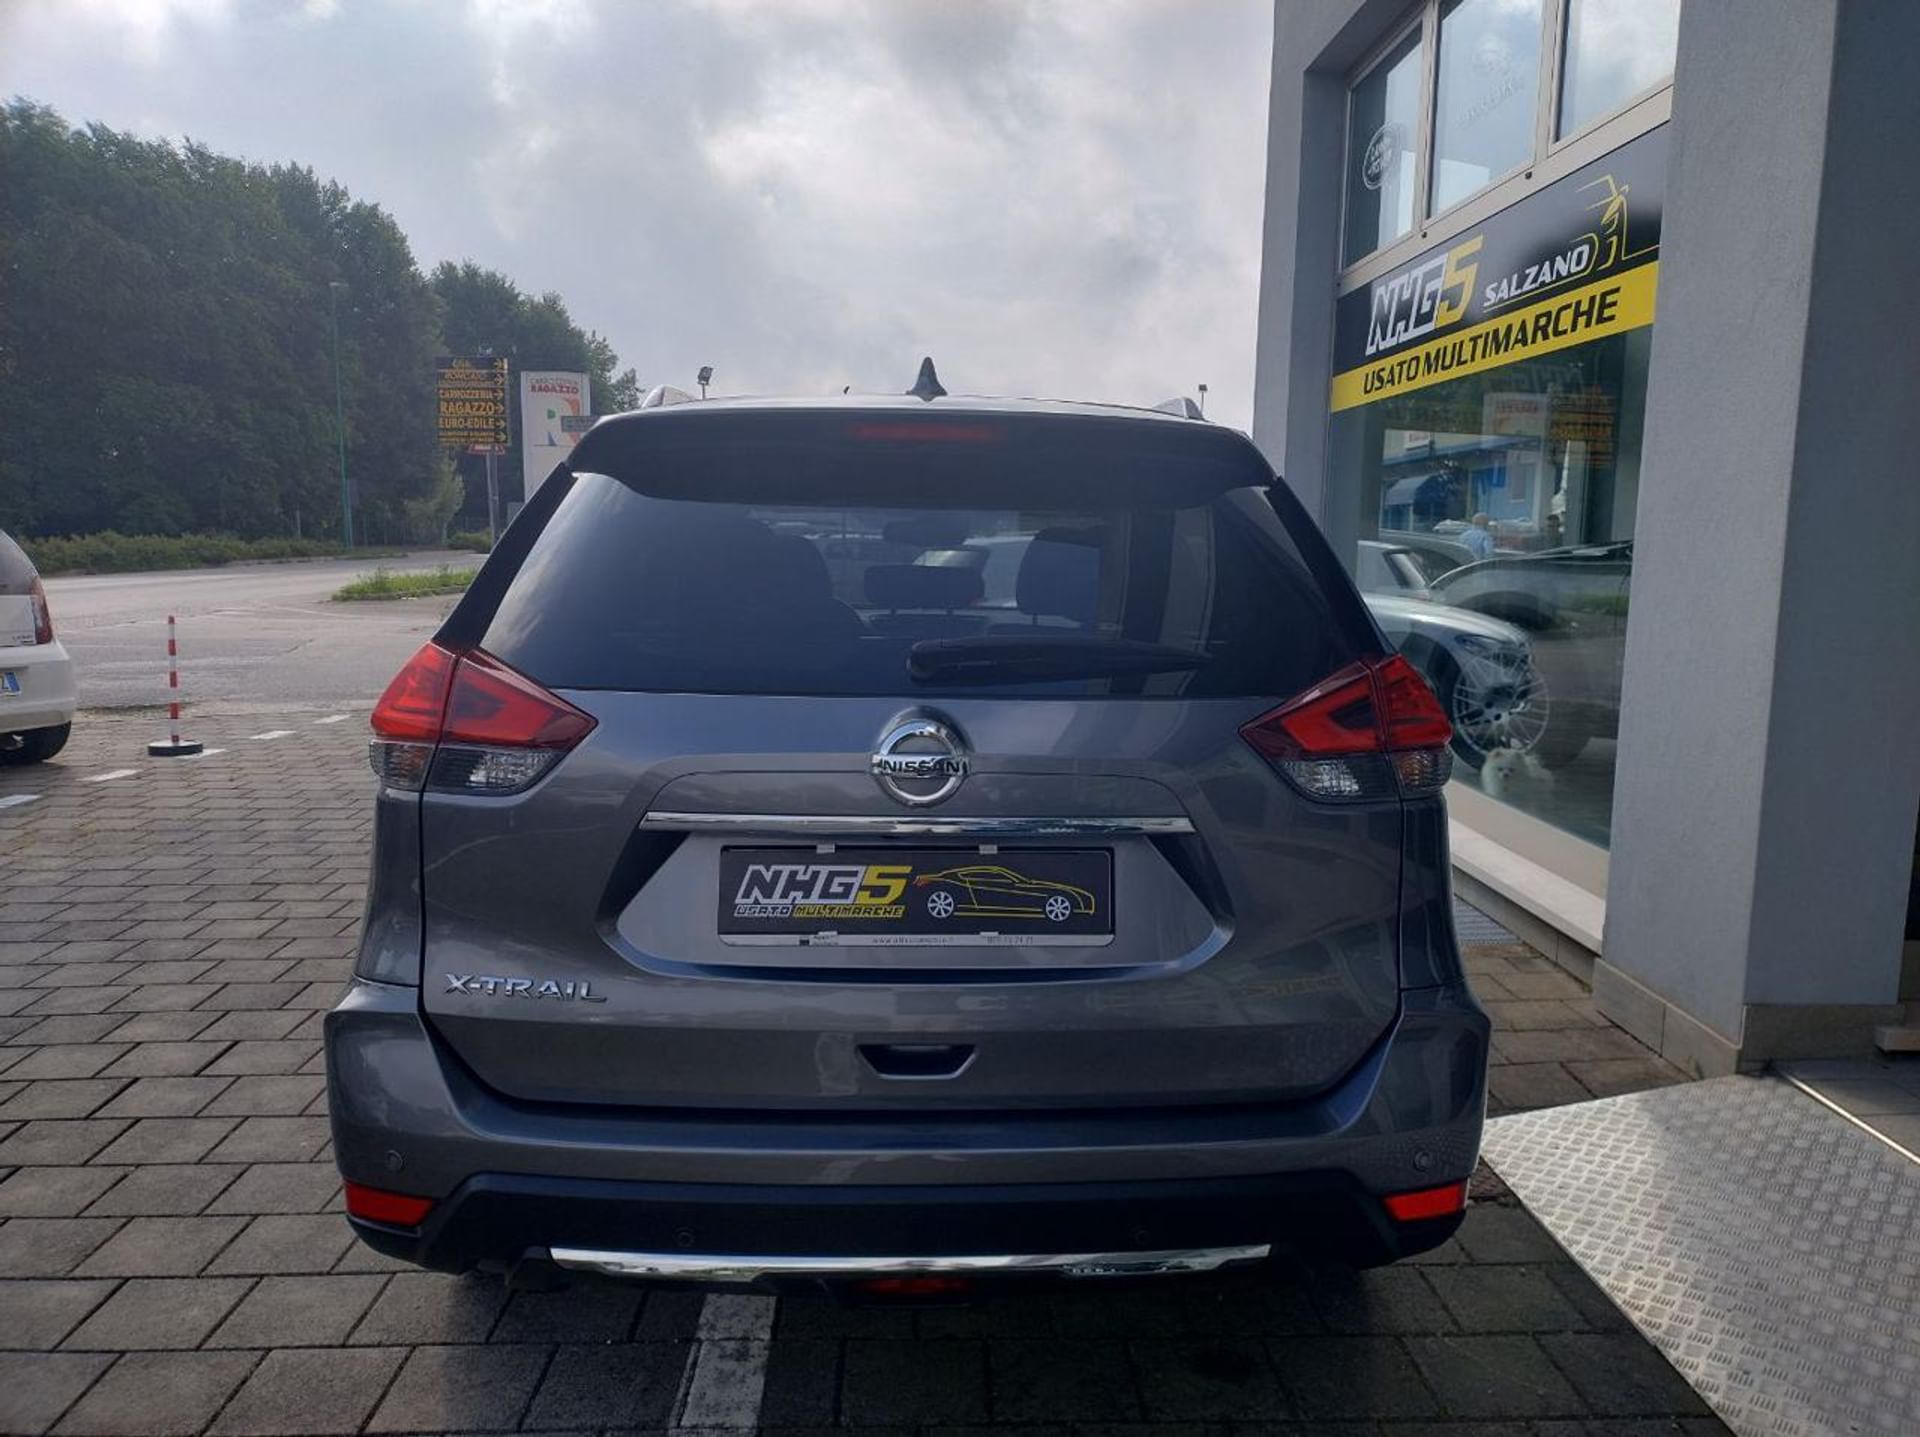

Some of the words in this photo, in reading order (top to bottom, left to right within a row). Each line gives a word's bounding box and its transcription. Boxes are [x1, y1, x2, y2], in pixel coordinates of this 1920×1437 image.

[1483, 244, 1590, 307] SALZANO
[1363, 355, 1420, 395] USATO
[1422, 286, 1621, 377] MULTIMARCHE
[530, 384, 579, 394] RAGAZZO
[440, 402, 495, 415] RAGAZZO
[881, 760, 961, 774] NISSAN
[734, 864, 912, 904] NHG5
[734, 904, 793, 917] USATO
[792, 904, 906, 917] MULTIMARCHE
[445, 973, 608, 1003] X-TRAIL
